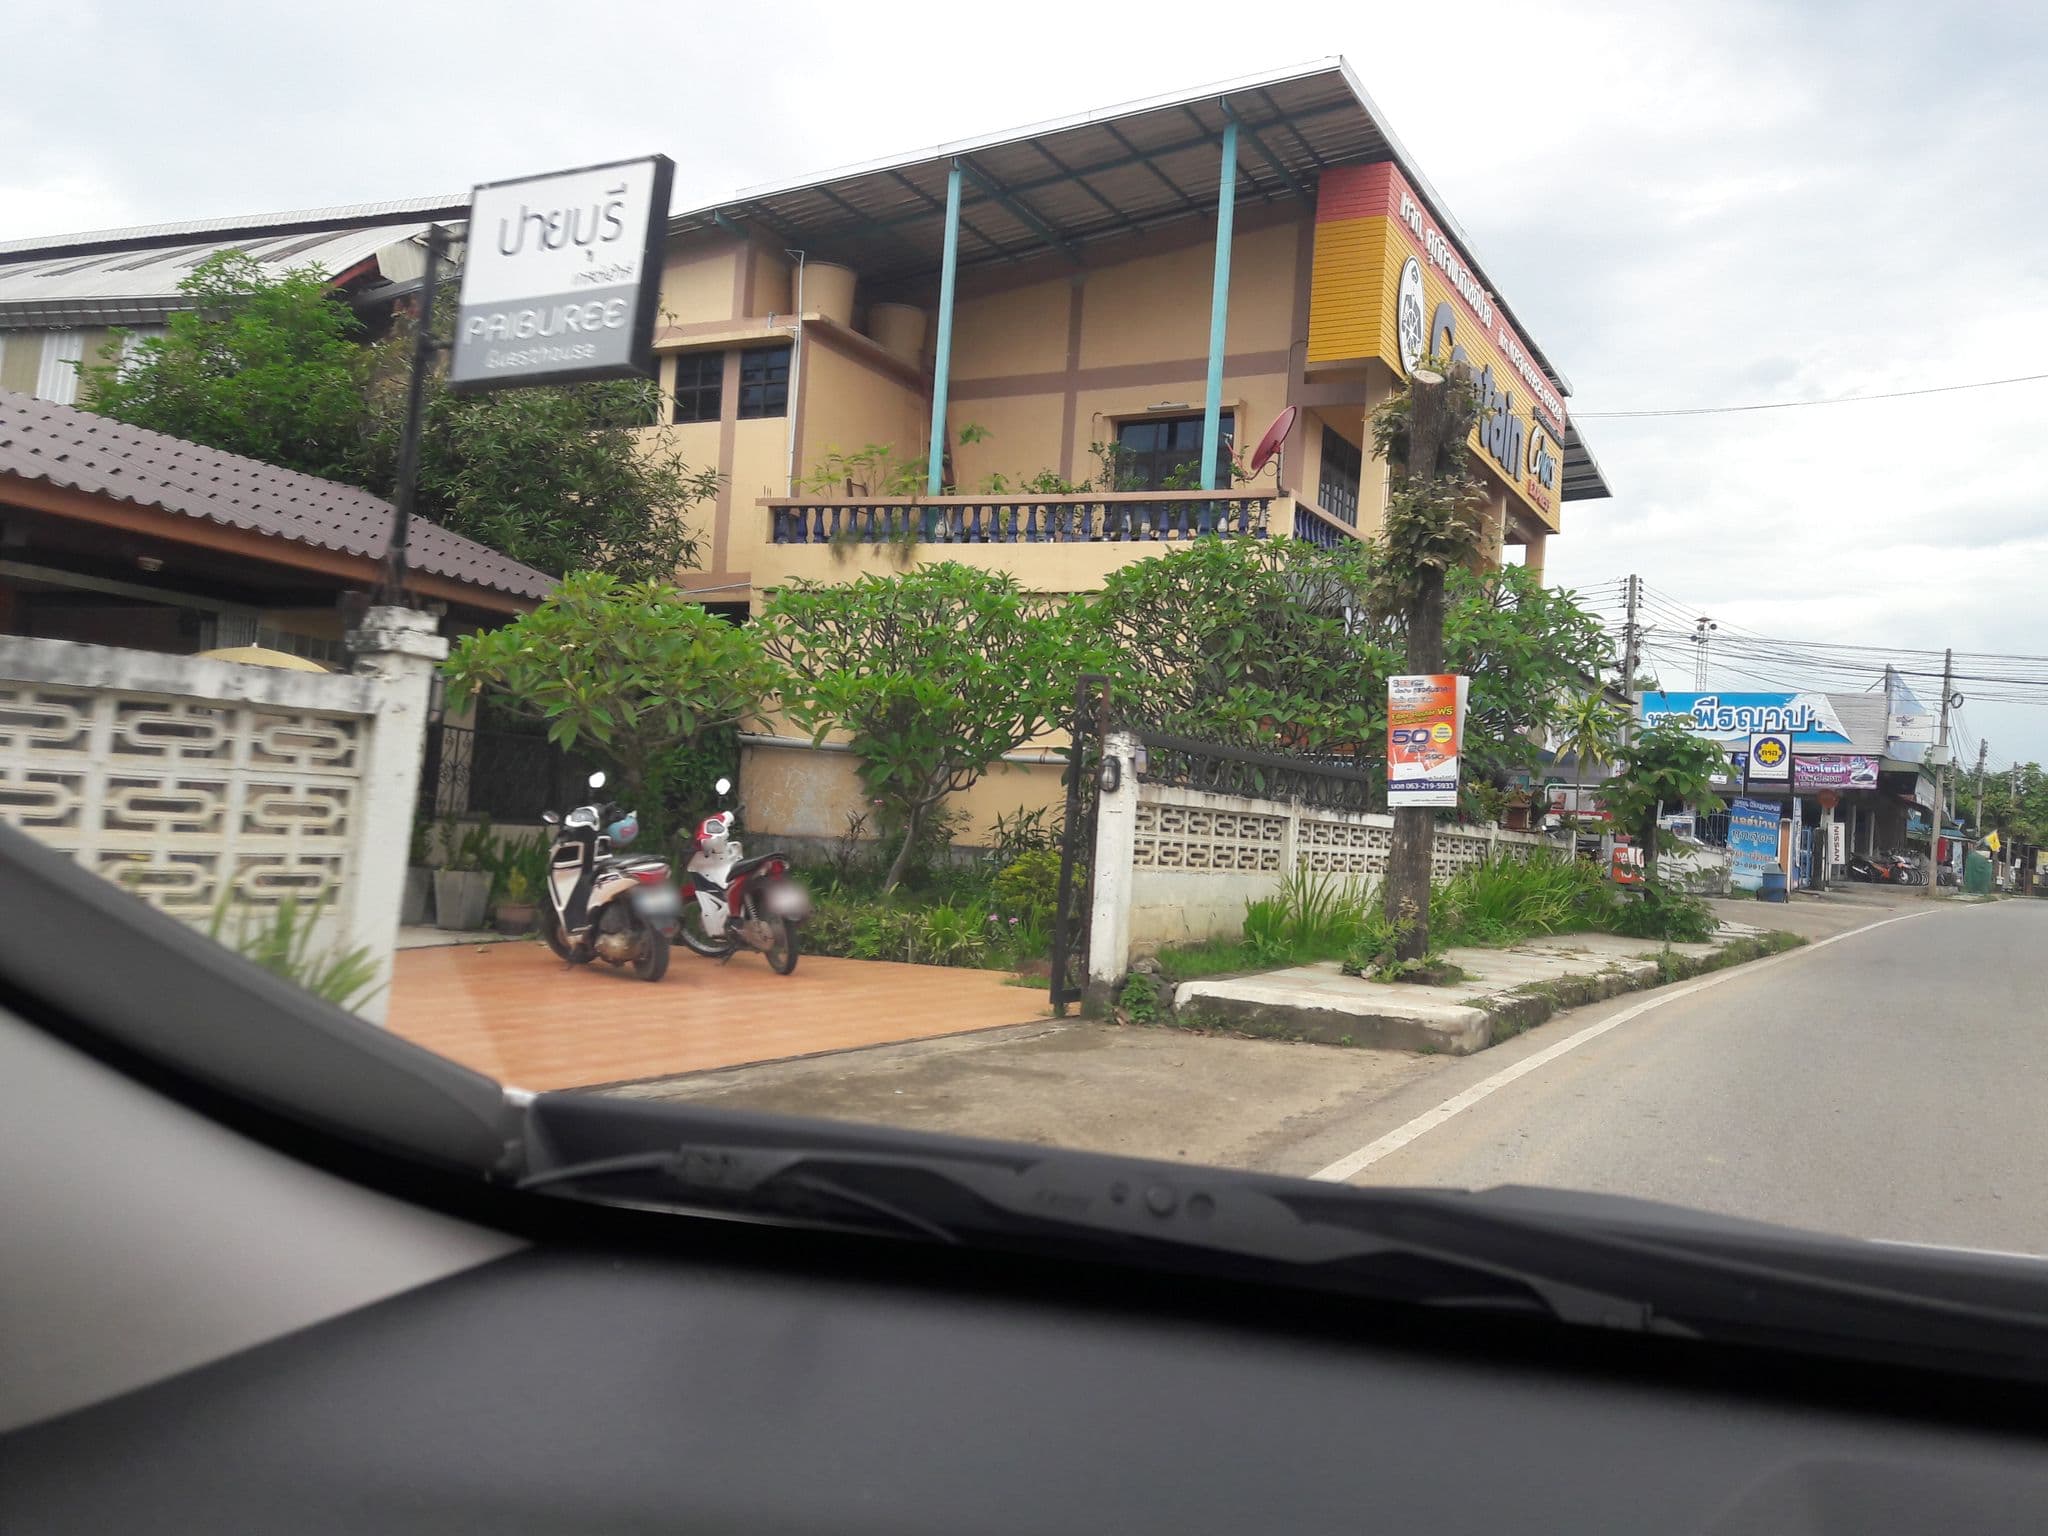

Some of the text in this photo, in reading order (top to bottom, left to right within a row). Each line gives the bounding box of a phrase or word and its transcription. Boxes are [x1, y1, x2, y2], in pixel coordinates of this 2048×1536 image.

[499, 182, 628, 262] ปายบุรี
[463, 297, 628, 345] PAIBUREE
[1392, 729, 1429, 744] 50
